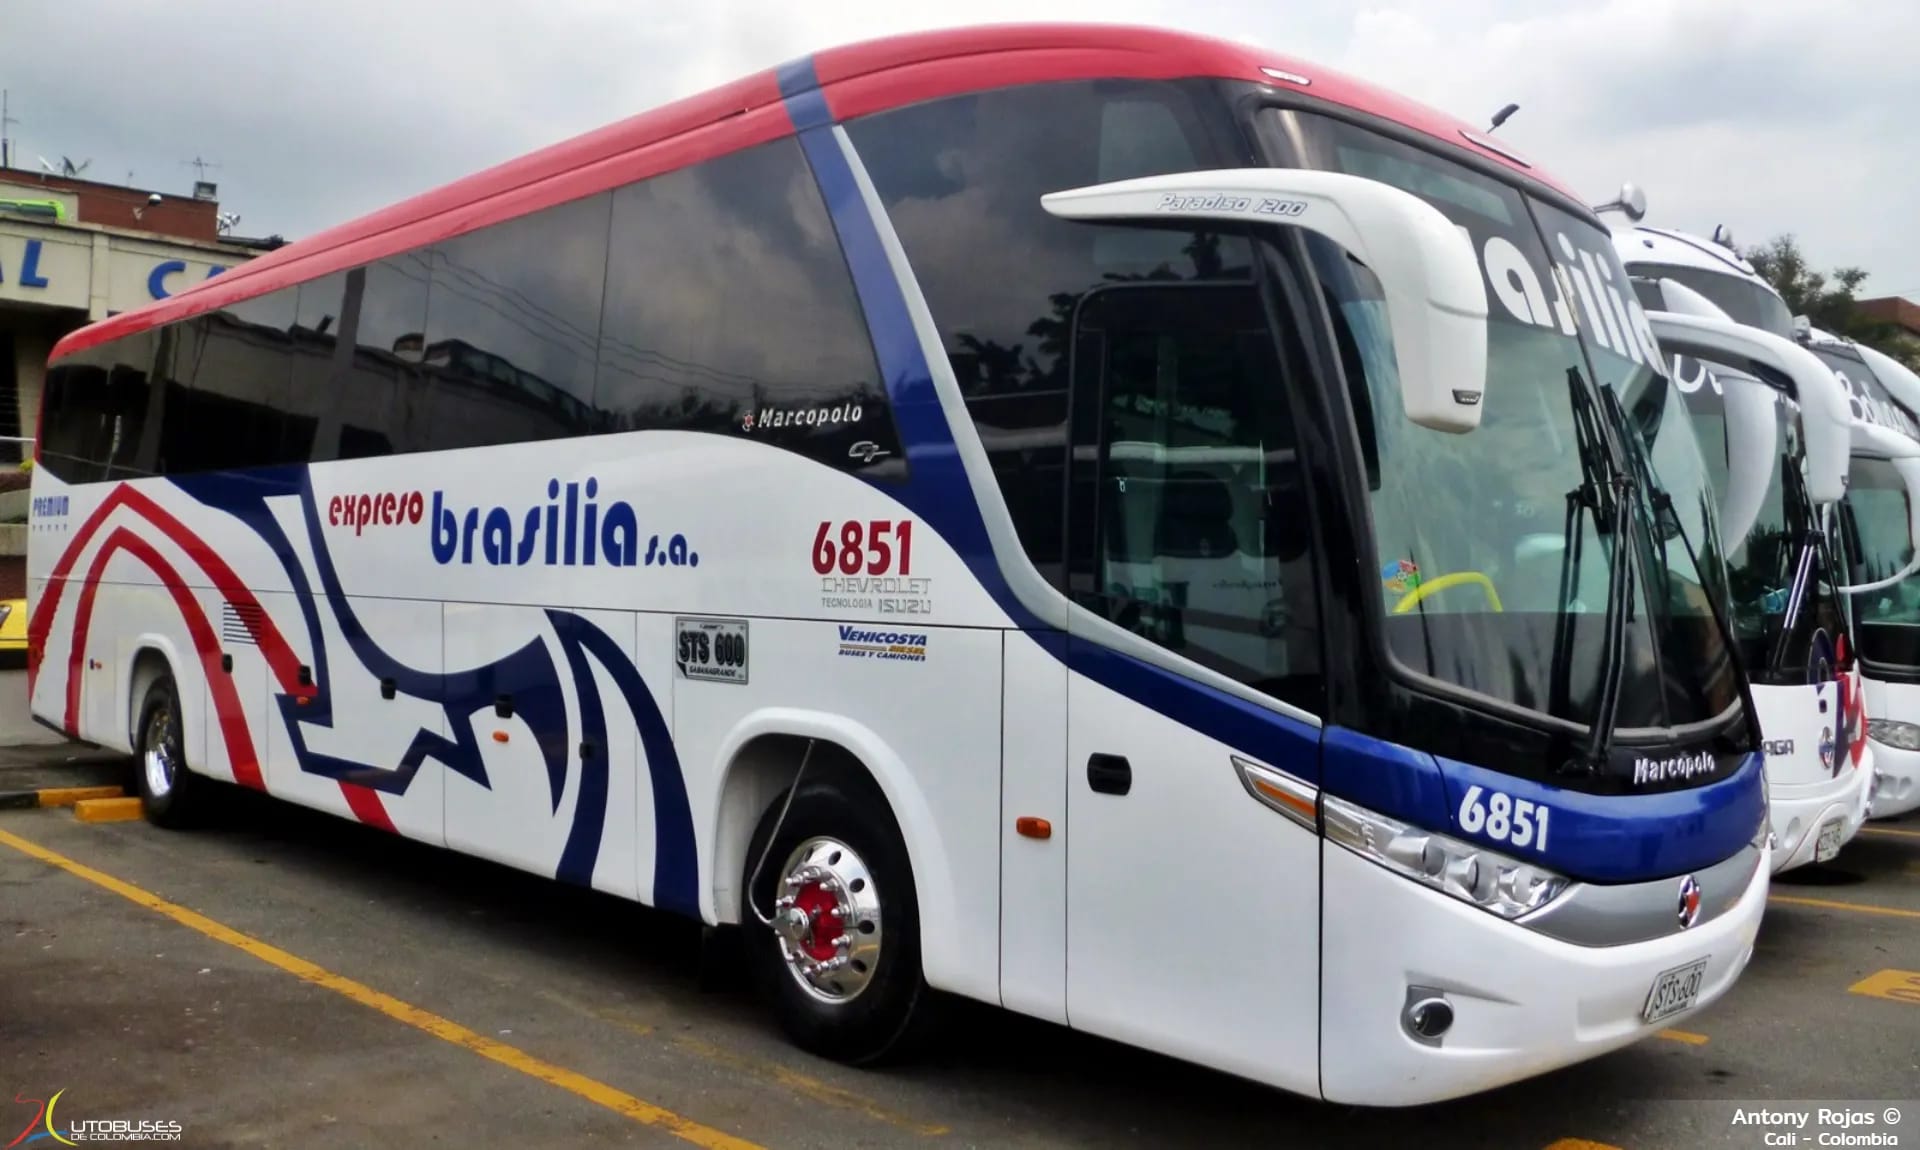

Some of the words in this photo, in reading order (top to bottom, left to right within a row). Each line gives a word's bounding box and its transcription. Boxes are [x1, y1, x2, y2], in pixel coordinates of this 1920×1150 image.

[1157, 193, 1251, 211] Paradiso
[1253, 198, 1308, 216] 1200
[1484, 232, 1671, 379] asilia
[758, 403, 862, 428] Marcopolo
[329, 491, 424, 536] expreso
[431, 477, 638, 567] brasilia
[645, 534, 699, 567] s.a.
[812, 520, 912, 576] 6851
[821, 577, 932, 594] CHEVROLET
[878, 599, 931, 614] ISUZU
[679, 630, 710, 665] STS
[714, 632, 745, 668] 600
[838, 624, 928, 646] VEHICOSTA
[838, 649, 866, 658] BUSES
[876, 652, 927, 662] CAMIONES
[1634, 751, 1715, 784] Marcopolo
[1459, 785, 1549, 852] 6851
